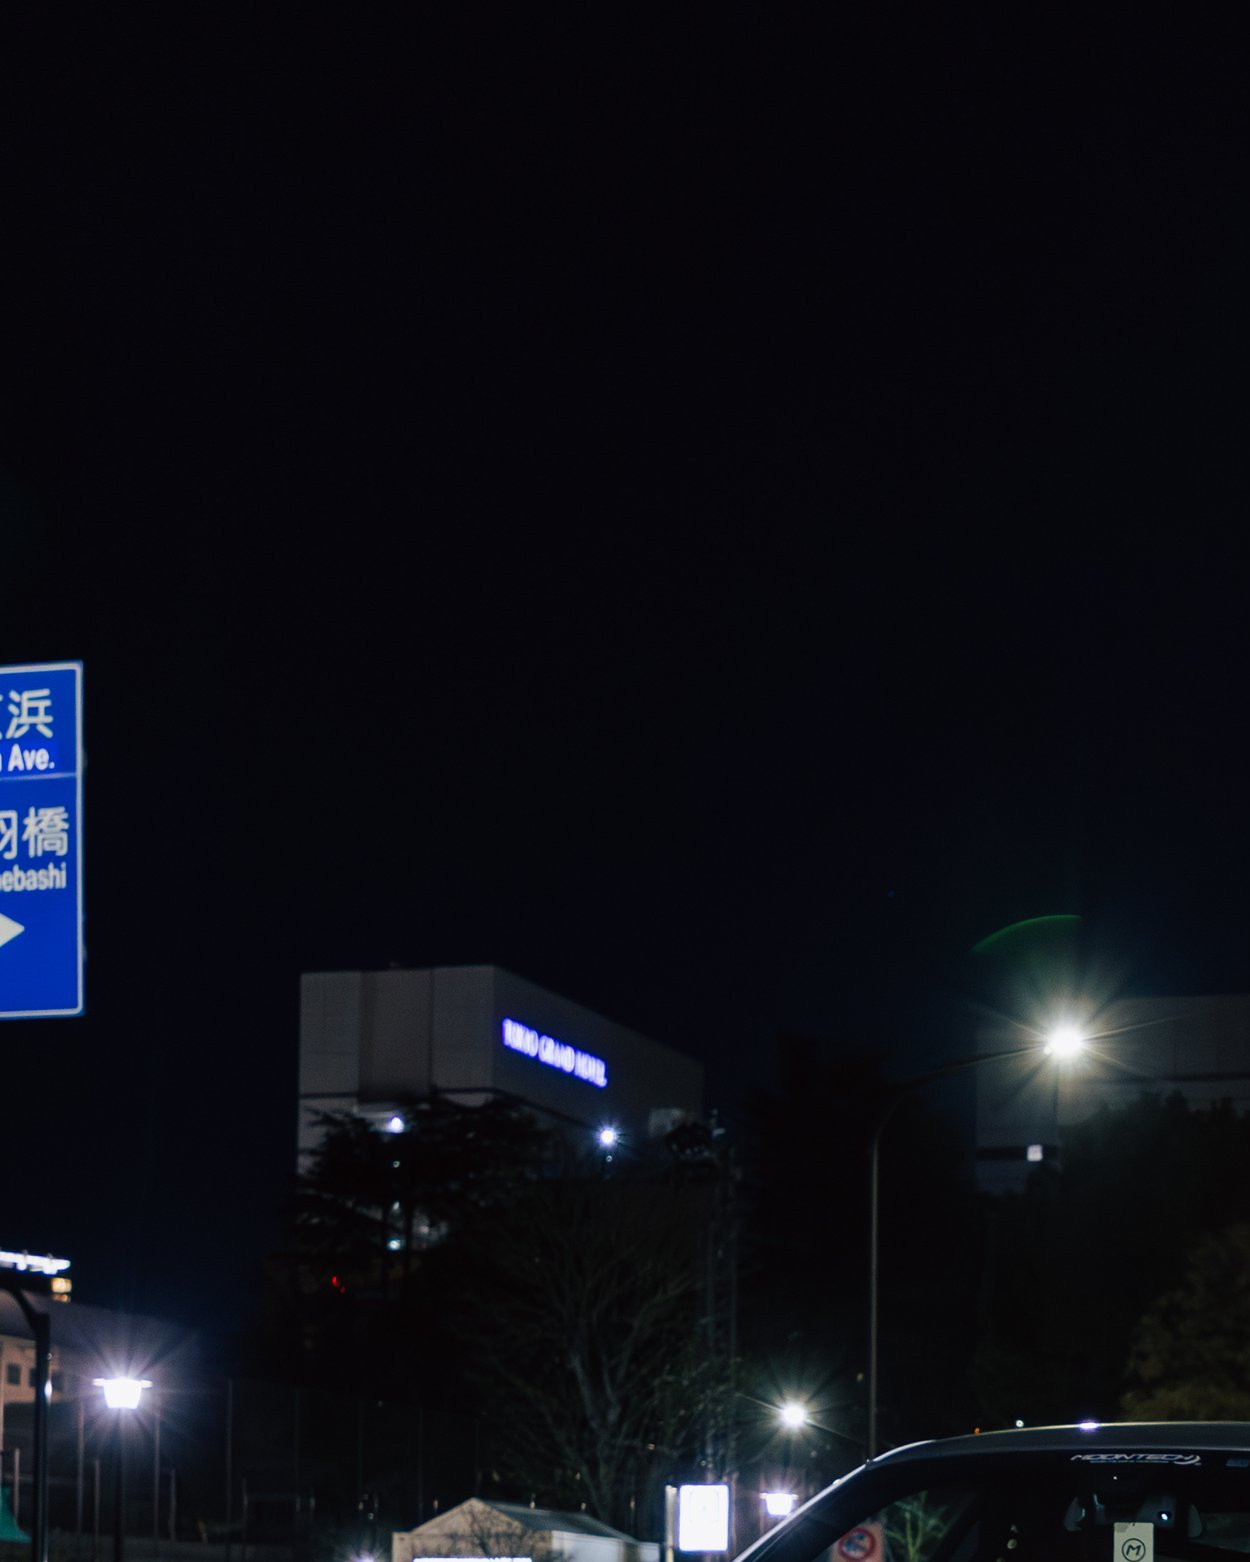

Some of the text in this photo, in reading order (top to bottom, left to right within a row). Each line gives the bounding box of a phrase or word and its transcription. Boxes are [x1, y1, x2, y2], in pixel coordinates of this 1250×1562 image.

[0, 688, 54, 739] 浜
[8, 743, 55, 772] Ave.
[0, 861, 67, 892] ebashi
